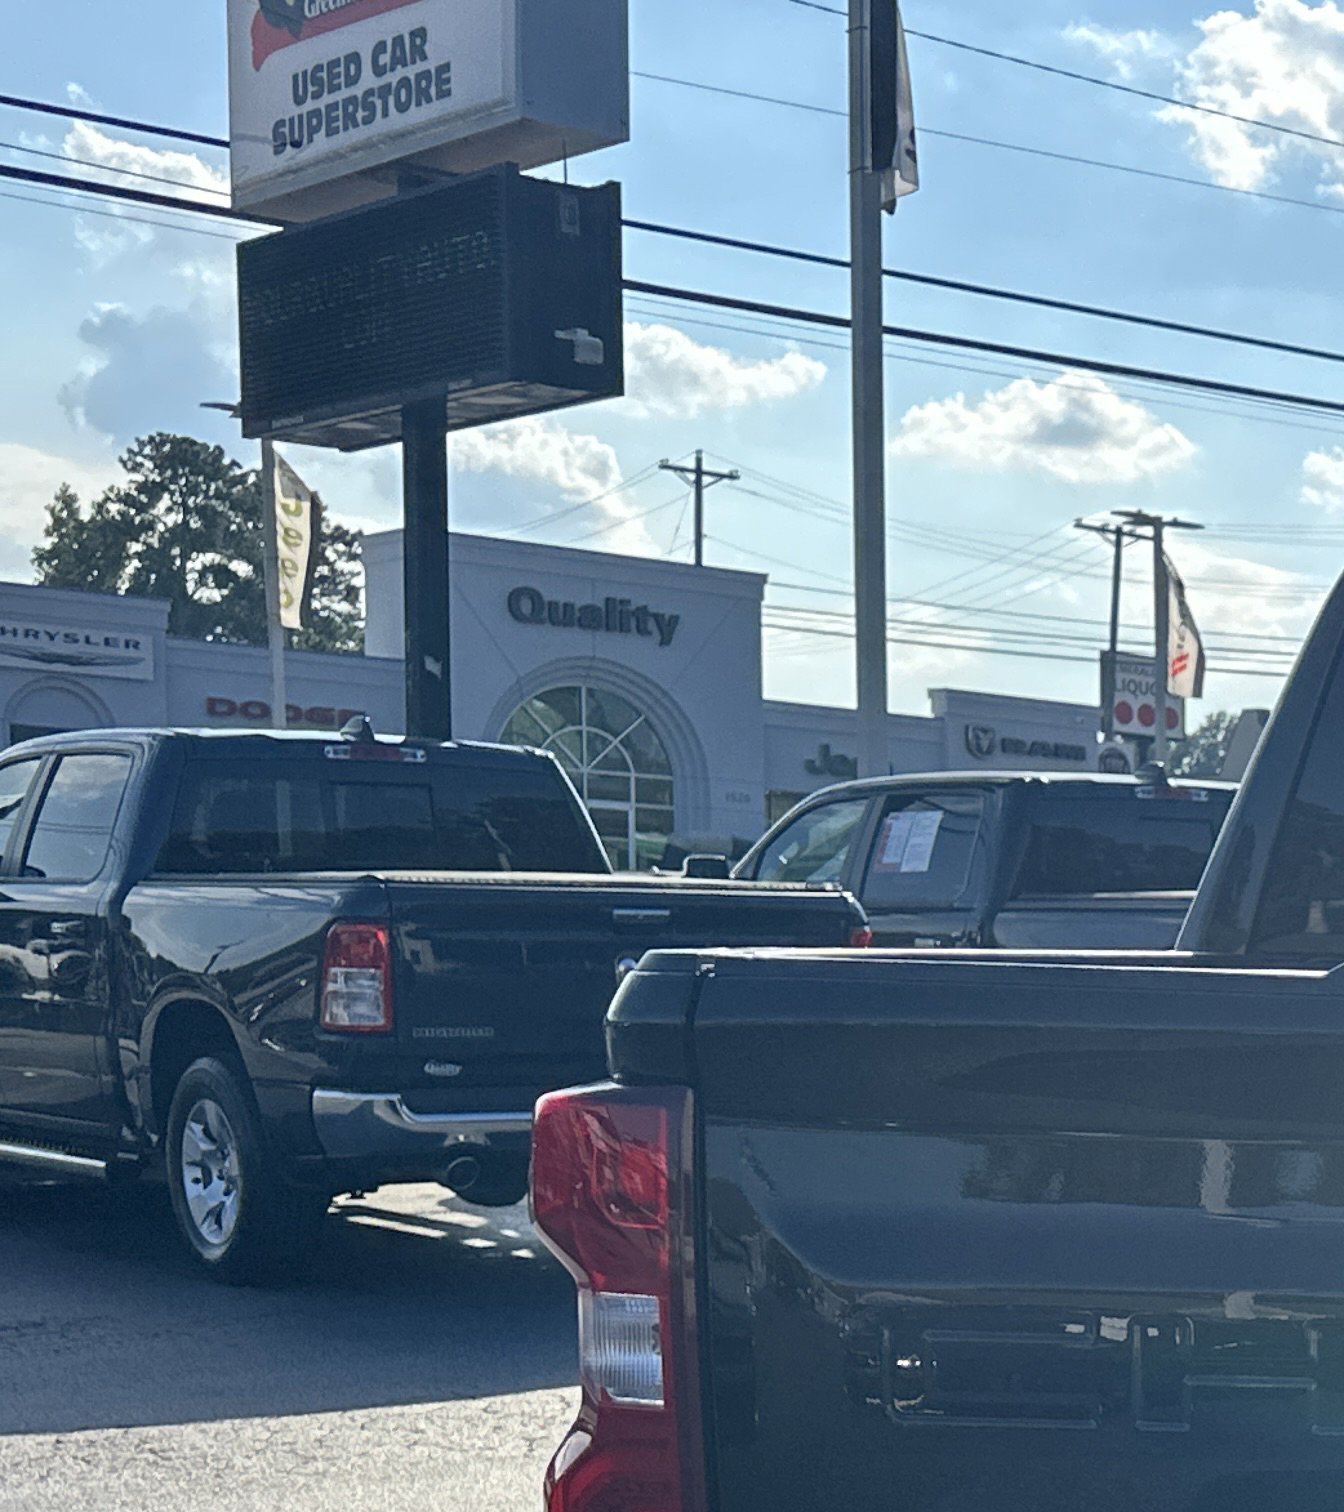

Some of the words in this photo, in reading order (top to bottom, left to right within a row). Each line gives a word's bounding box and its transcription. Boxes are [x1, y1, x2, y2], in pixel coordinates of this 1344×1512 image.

[292, 51, 361, 106] USED
[371, 26, 428, 78] CAR
[272, 61, 452, 155] SUPERSTORE
[0, 625, 142, 650] HRYSLER
[507, 586, 680, 647] Quality
